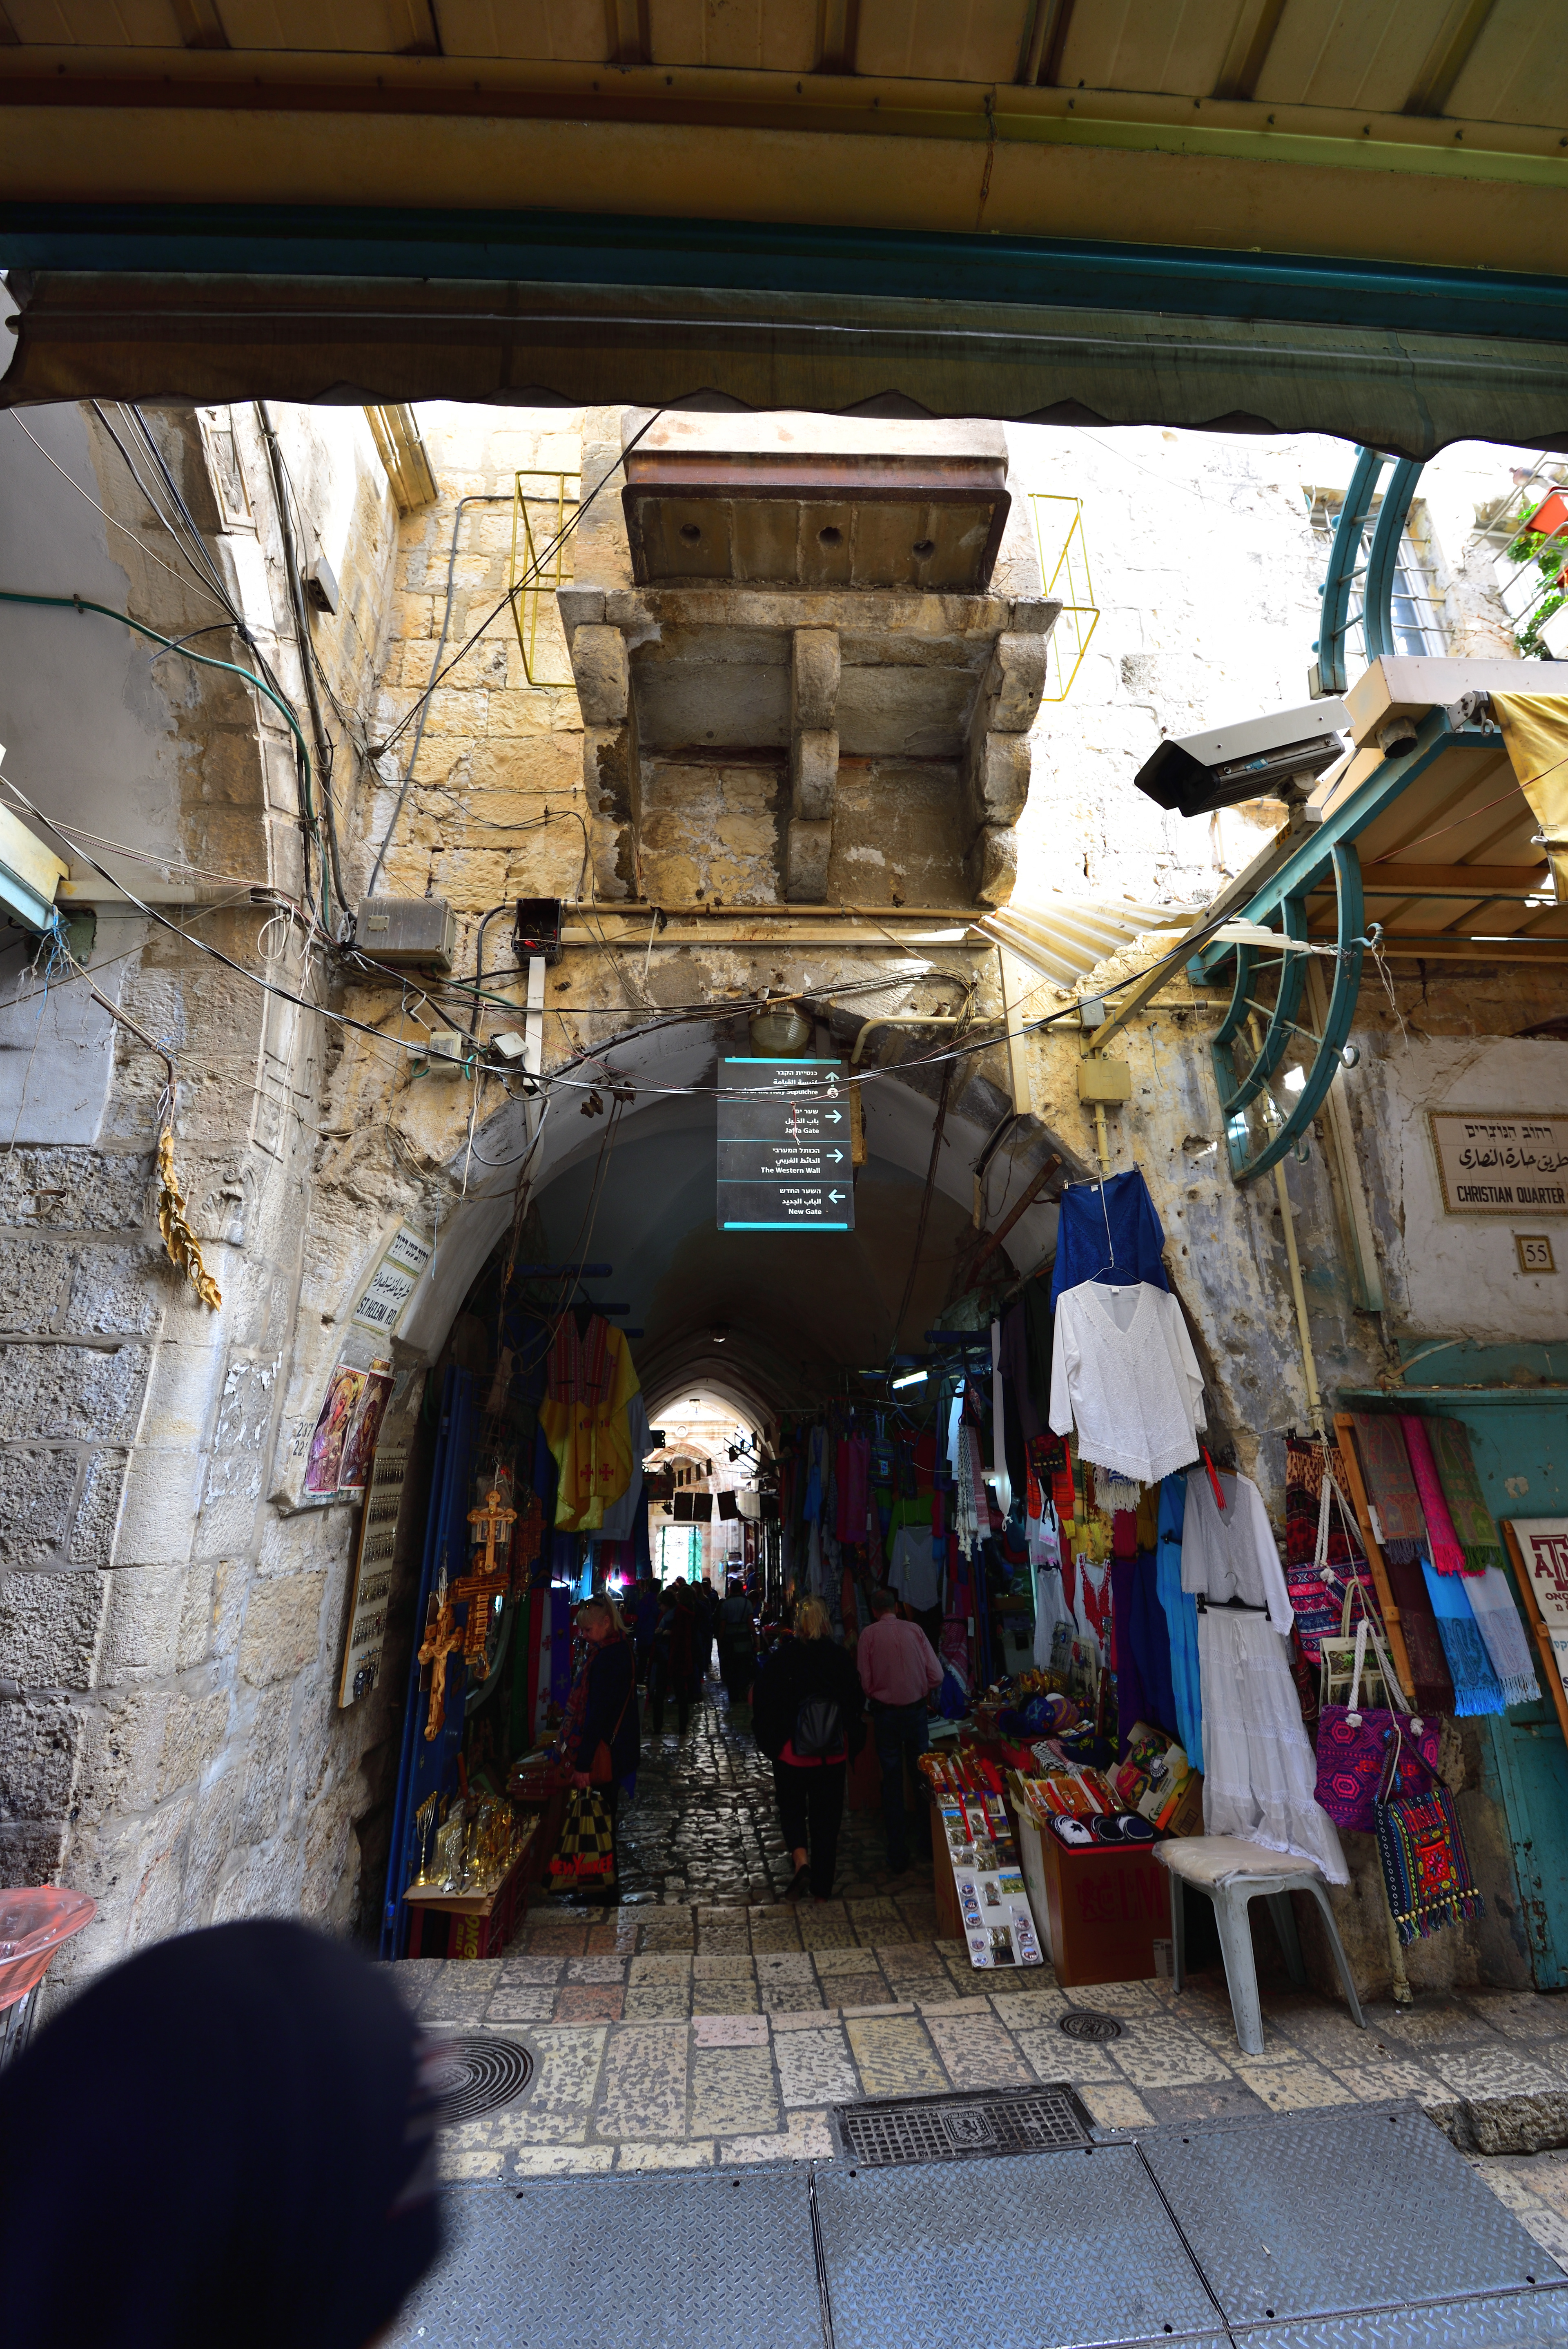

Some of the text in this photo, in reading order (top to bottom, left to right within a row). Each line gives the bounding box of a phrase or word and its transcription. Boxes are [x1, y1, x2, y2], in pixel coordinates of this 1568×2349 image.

[775, 1157, 798, 1166] الغربي
[1506, 1148, 1537, 1169] حارة
[1457, 1186, 1566, 1204] CHRISTIAN QUARTER
[1526, 1245, 1547, 1262] 55
[356, 1297, 397, 1325] ST. HELENA RD.
[296, 1422, 314, 1437] 237
[1117, 1866, 1164, 1921] L&M
